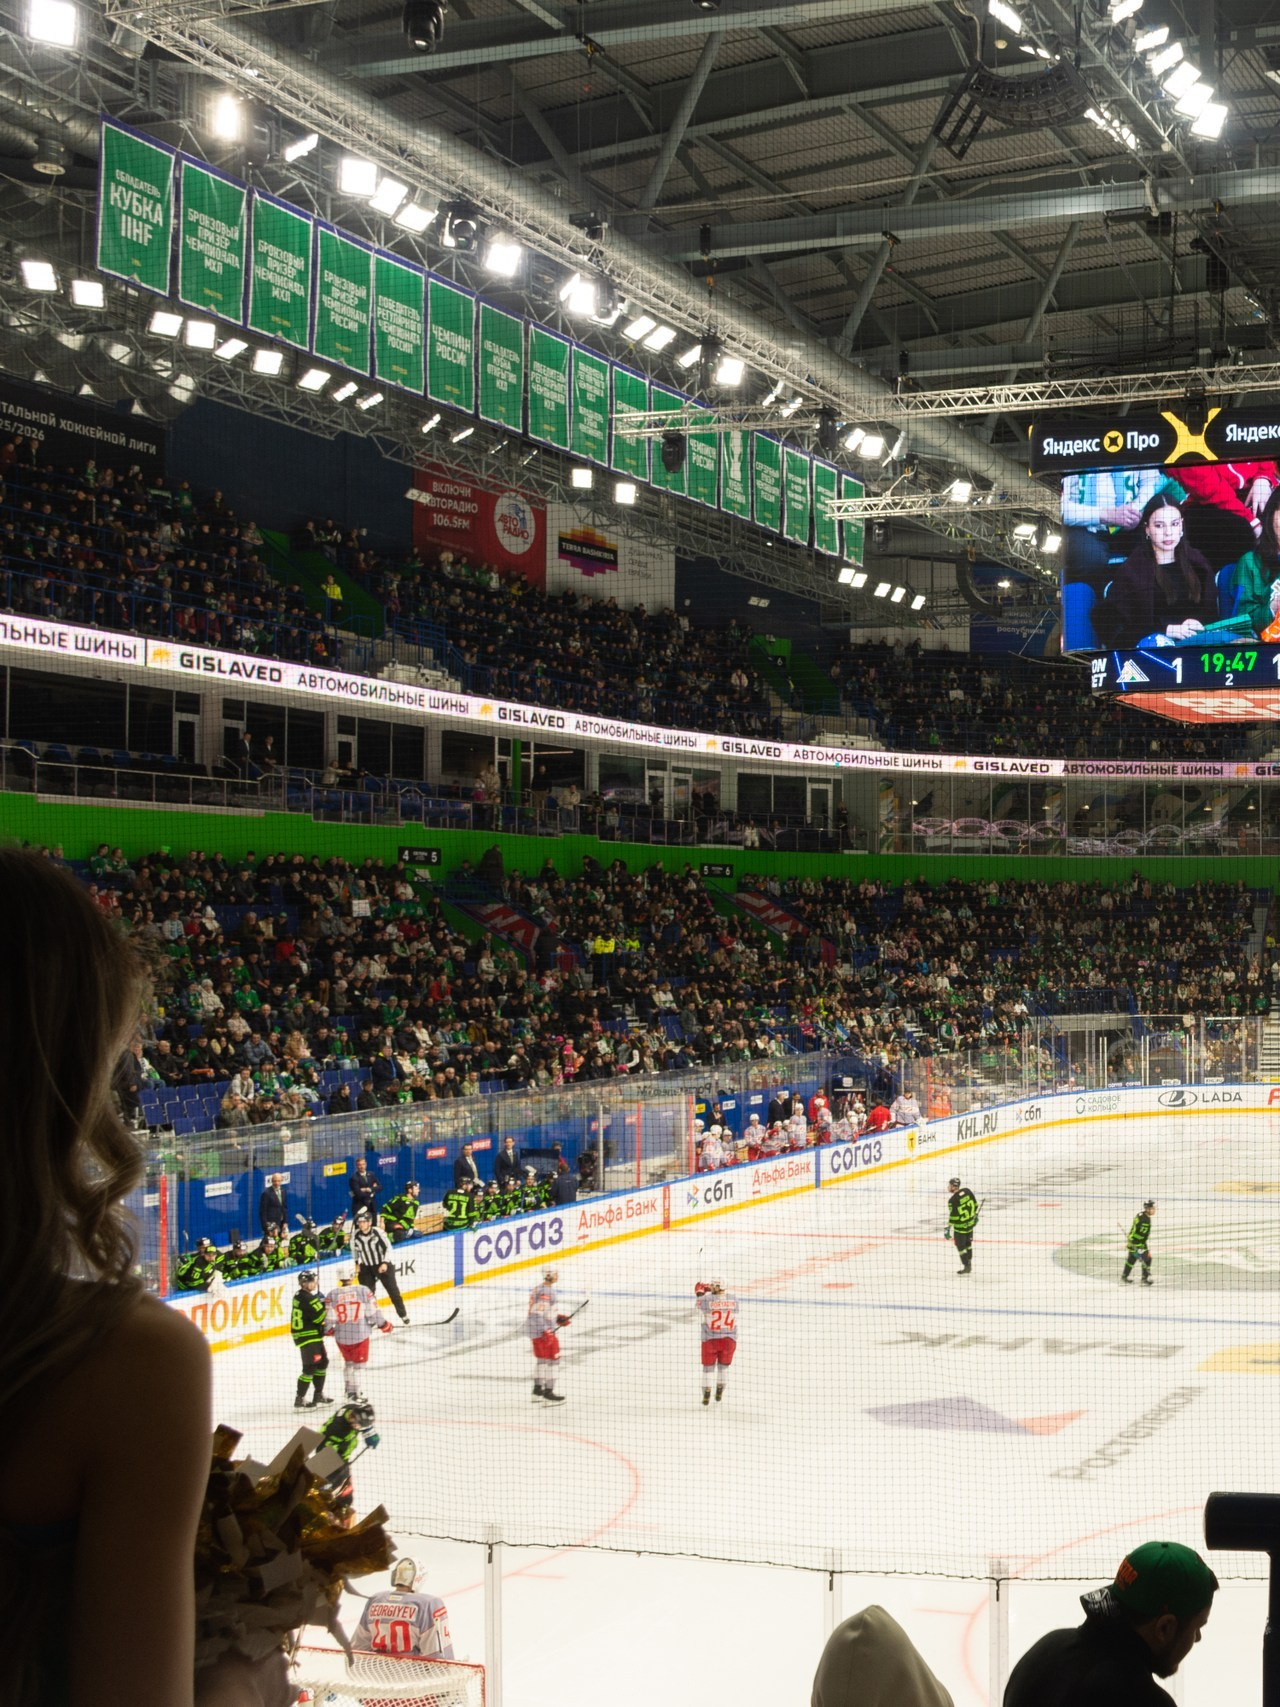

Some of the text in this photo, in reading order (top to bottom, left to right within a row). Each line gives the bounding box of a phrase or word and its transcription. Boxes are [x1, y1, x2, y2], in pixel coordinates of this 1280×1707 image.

[110, 182, 162, 227] КУБКА
[121, 214, 153, 246] IIHF
[188, 208, 239, 242] БРОНЗОВЫЙ
[185, 235, 240, 269] ЧЕМПИОНАТА
[204, 256, 222, 275] МХЛ
[60, 419, 126, 447] ХОККЕЙНОЙ
[129, 438, 157, 455] ЛИГИ
[1043, 432, 1160, 456] Яндекс Про
[432, 482, 472, 497] ВКЛЮЧИ
[498, 513, 519, 527] АВТО
[503, 525, 530, 540] РАДИО
[562, 542, 581, 553] TERRA
[74, 631, 137, 660] ШИНЫ
[1091, 657, 1107, 674] ON
[1172, 657, 1183, 684] 1
[1200, 651, 1258, 673] 19:47
[180, 652, 469, 714] GISLAVED АВТОМОБИЛЬНЫЕ ШИНЫ
[1091, 673, 1107, 688] ET
[1224, 673, 1234, 686] 2
[498, 707, 698, 748] GISLAVED АВТОМОБИЛЬНЫЕ ШИНЫ
[722, 741, 943, 769] GISLAVED АВТОМОБИЛЬНЫЕ ШИНЫ
[973, 760, 1224, 776] GISLAVED АВТОМОБИЛЬНЫЕ ШИНЫ
[402, 849, 438, 863] 4 5
[703, 865, 731, 876] 5 6
[1088, 1095, 1121, 1104] САДОВОЕ
[1088, 1103, 1118, 1112] КОЛЬЦО
[1202, 1091, 1243, 1103] LADA
[1024, 1105, 1041, 1121] сбп
[957, 1113, 998, 1141] KHL.RU
[917, 1131, 937, 1146] БАНК
[830, 1140, 883, 1174] согаз
[753, 1160, 811, 1187] Альфа Банк
[704, 1180, 734, 1205] сбп
[447, 1200, 468, 1219] 21
[578, 1198, 658, 1231] Альфа Банк
[473, 1217, 564, 1266] согаз
[395, 1259, 416, 1277] НК
[188, 1283, 286, 1335] ПОИСК
[336, 1301, 361, 1324] 87
[710, 1310, 735, 1331] 24
[369, 1602, 418, 1619] GEORGIYEV
[371, 1618, 412, 1653] 40
